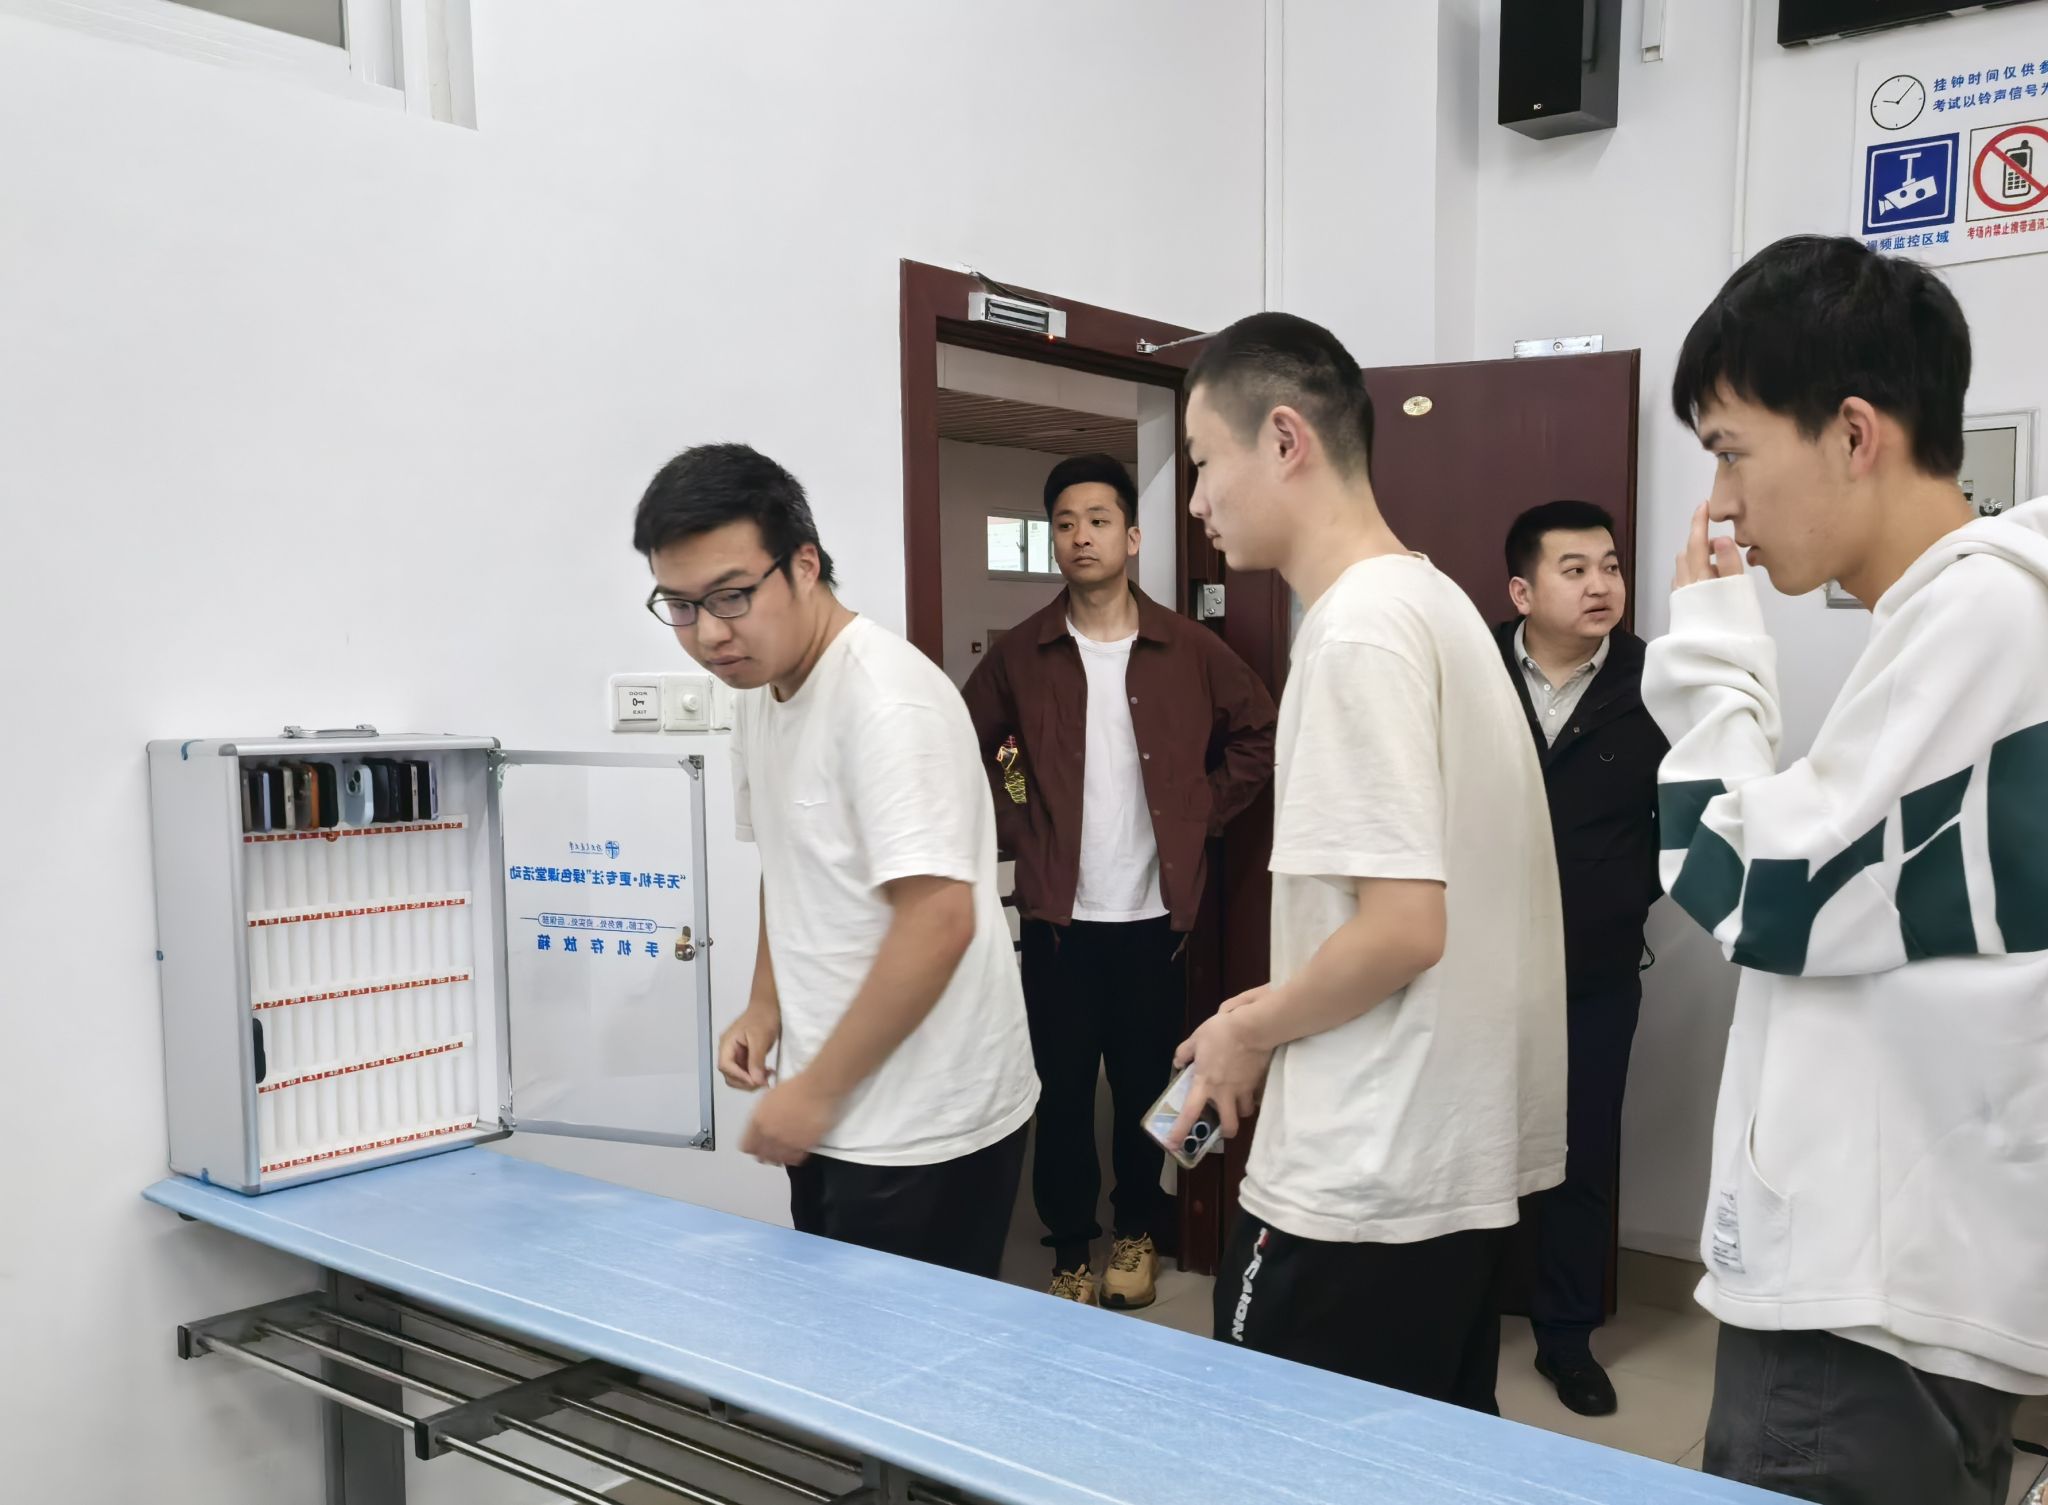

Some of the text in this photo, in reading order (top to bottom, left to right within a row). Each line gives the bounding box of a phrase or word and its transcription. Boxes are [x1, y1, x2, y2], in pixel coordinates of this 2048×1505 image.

[1933, 60, 2048, 93] 挂钟时间仅供参
[1865, 230, 1950, 252] 视频监控区域
